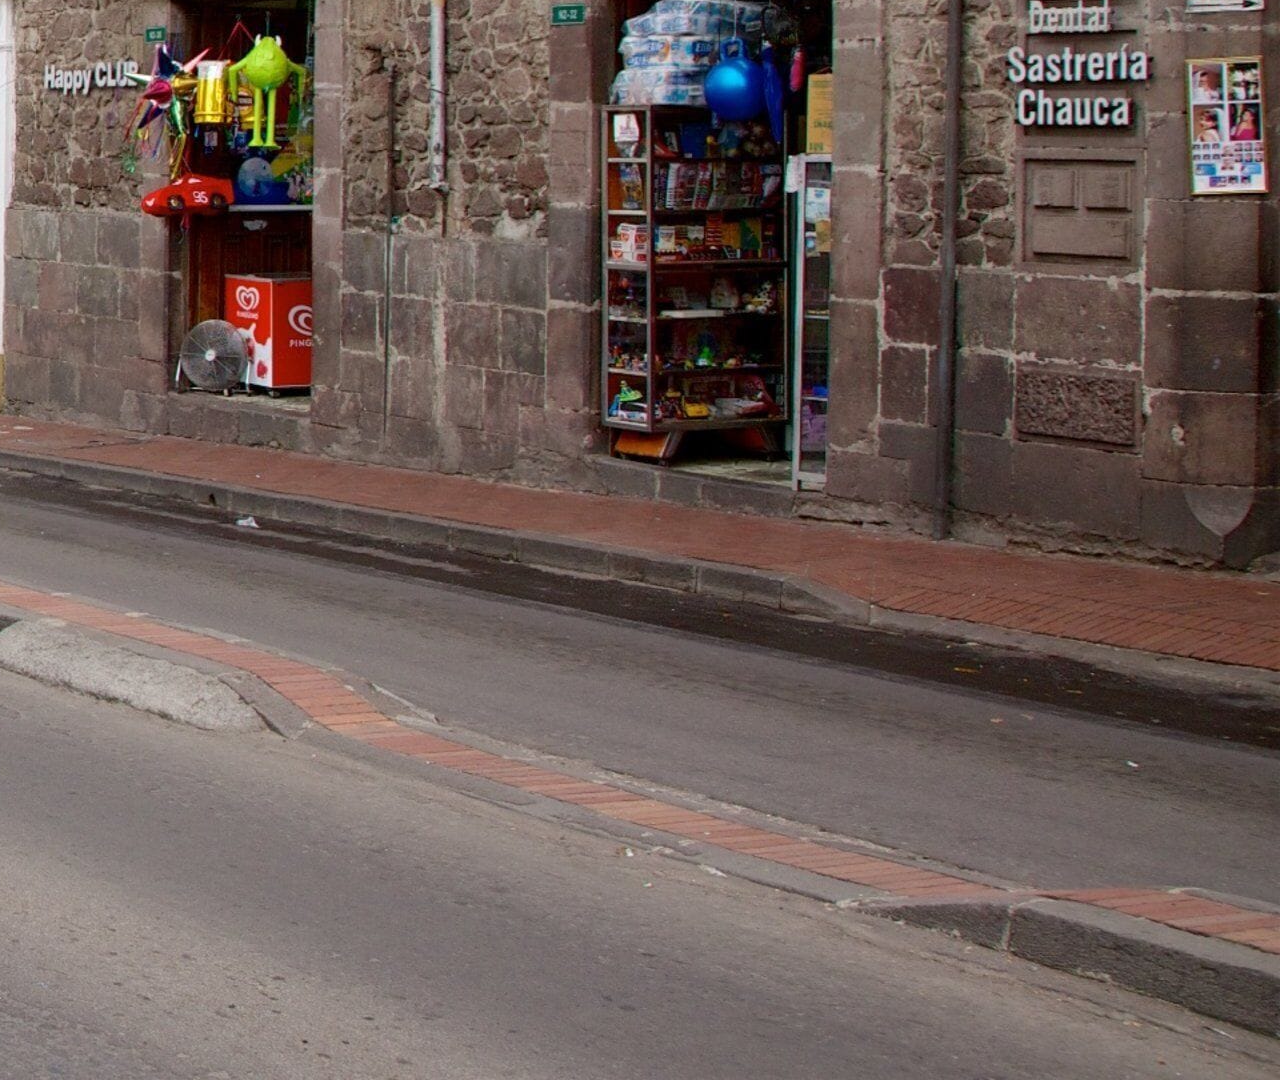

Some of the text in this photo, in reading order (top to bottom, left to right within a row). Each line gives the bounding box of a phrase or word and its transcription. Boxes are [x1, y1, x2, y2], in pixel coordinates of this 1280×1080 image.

[44, 64, 91, 95] Happy
[1007, 43, 1150, 82] Sastrería
[1018, 89, 1130, 126] Chauca
